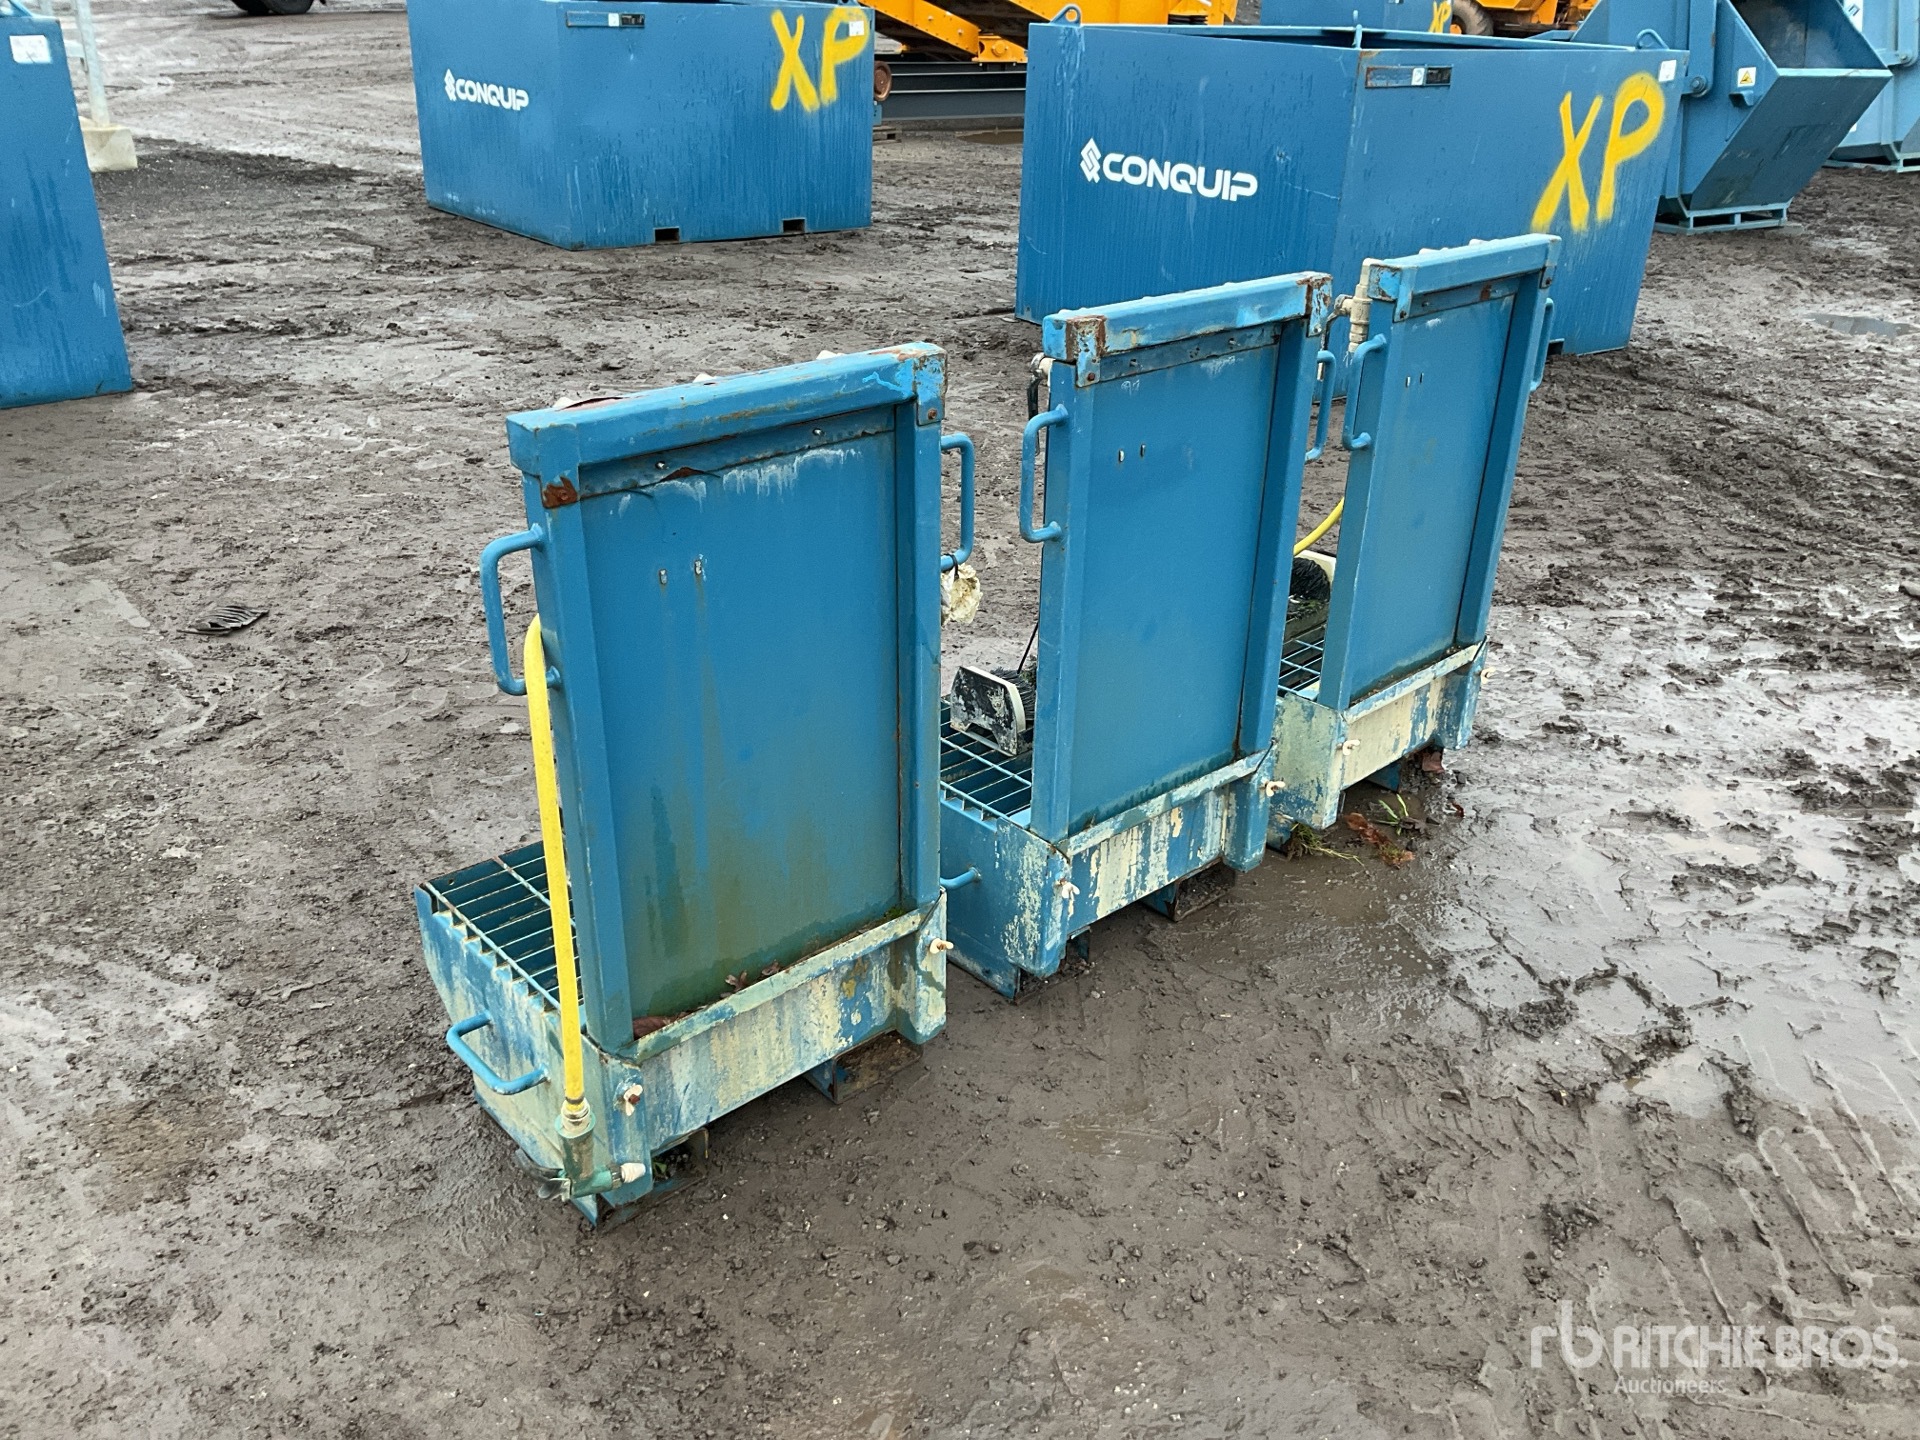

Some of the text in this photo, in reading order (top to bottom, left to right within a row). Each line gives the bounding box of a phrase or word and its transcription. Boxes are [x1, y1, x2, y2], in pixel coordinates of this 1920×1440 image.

[456, 77, 529, 111] CONQUIP
[770, 7, 870, 111] XP
[1103, 152, 1259, 202] CONQUIP
[1532, 72, 1666, 232] XP
